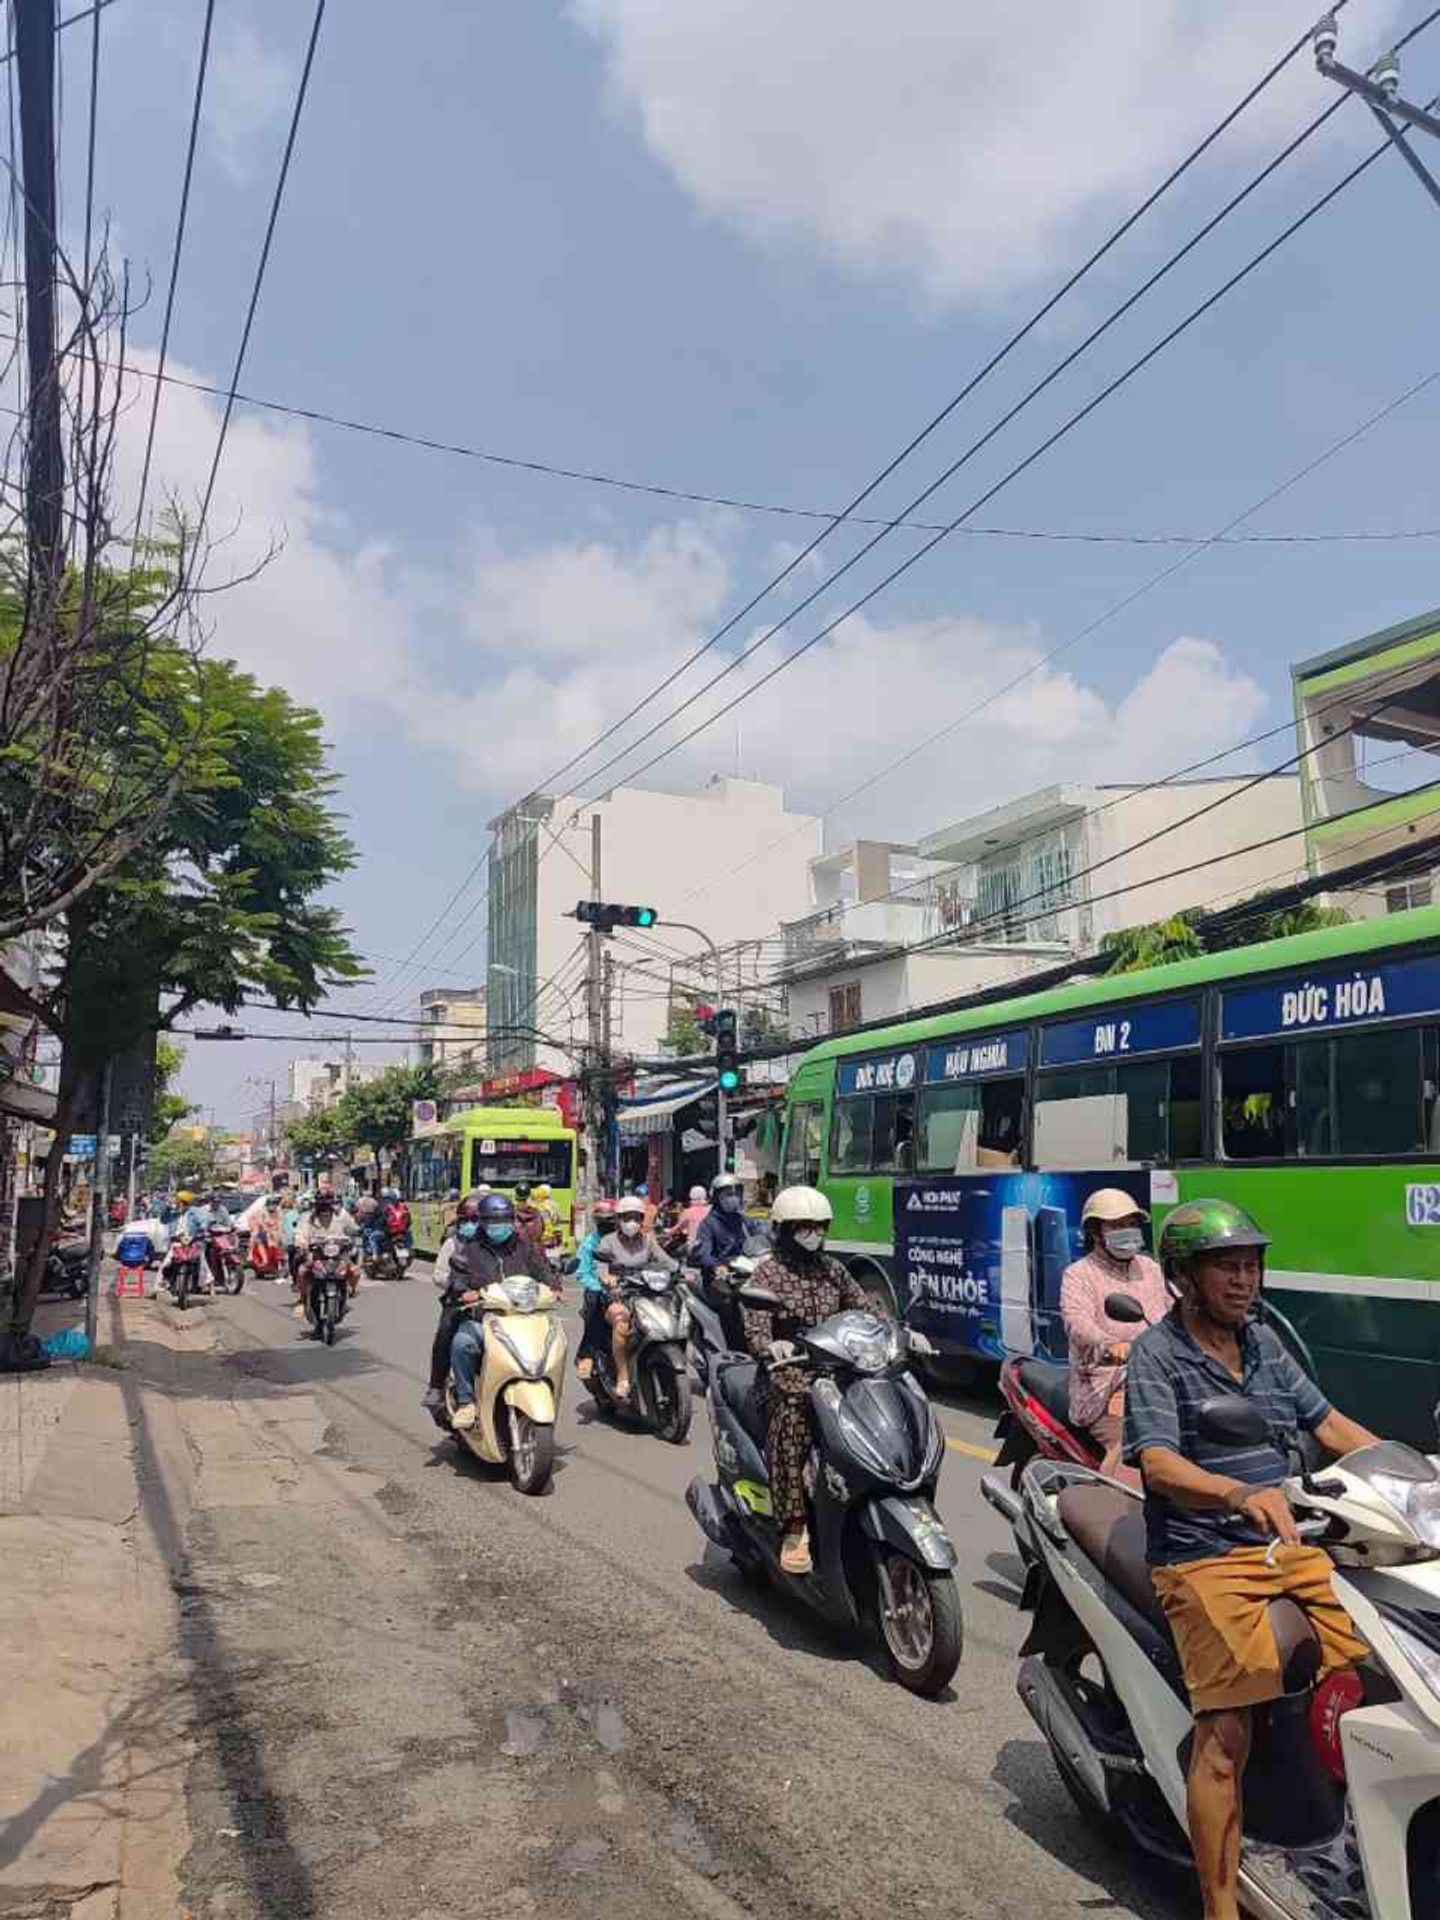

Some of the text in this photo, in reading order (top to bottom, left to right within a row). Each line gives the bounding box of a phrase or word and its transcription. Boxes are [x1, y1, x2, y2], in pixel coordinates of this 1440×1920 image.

[1282, 972, 1385, 1025] ĐỨC HÒA
[1120, 1021, 1131, 1049] 2
[908, 1246, 936, 1263] CÔNG
[941, 1270, 988, 1303] KHỎE
